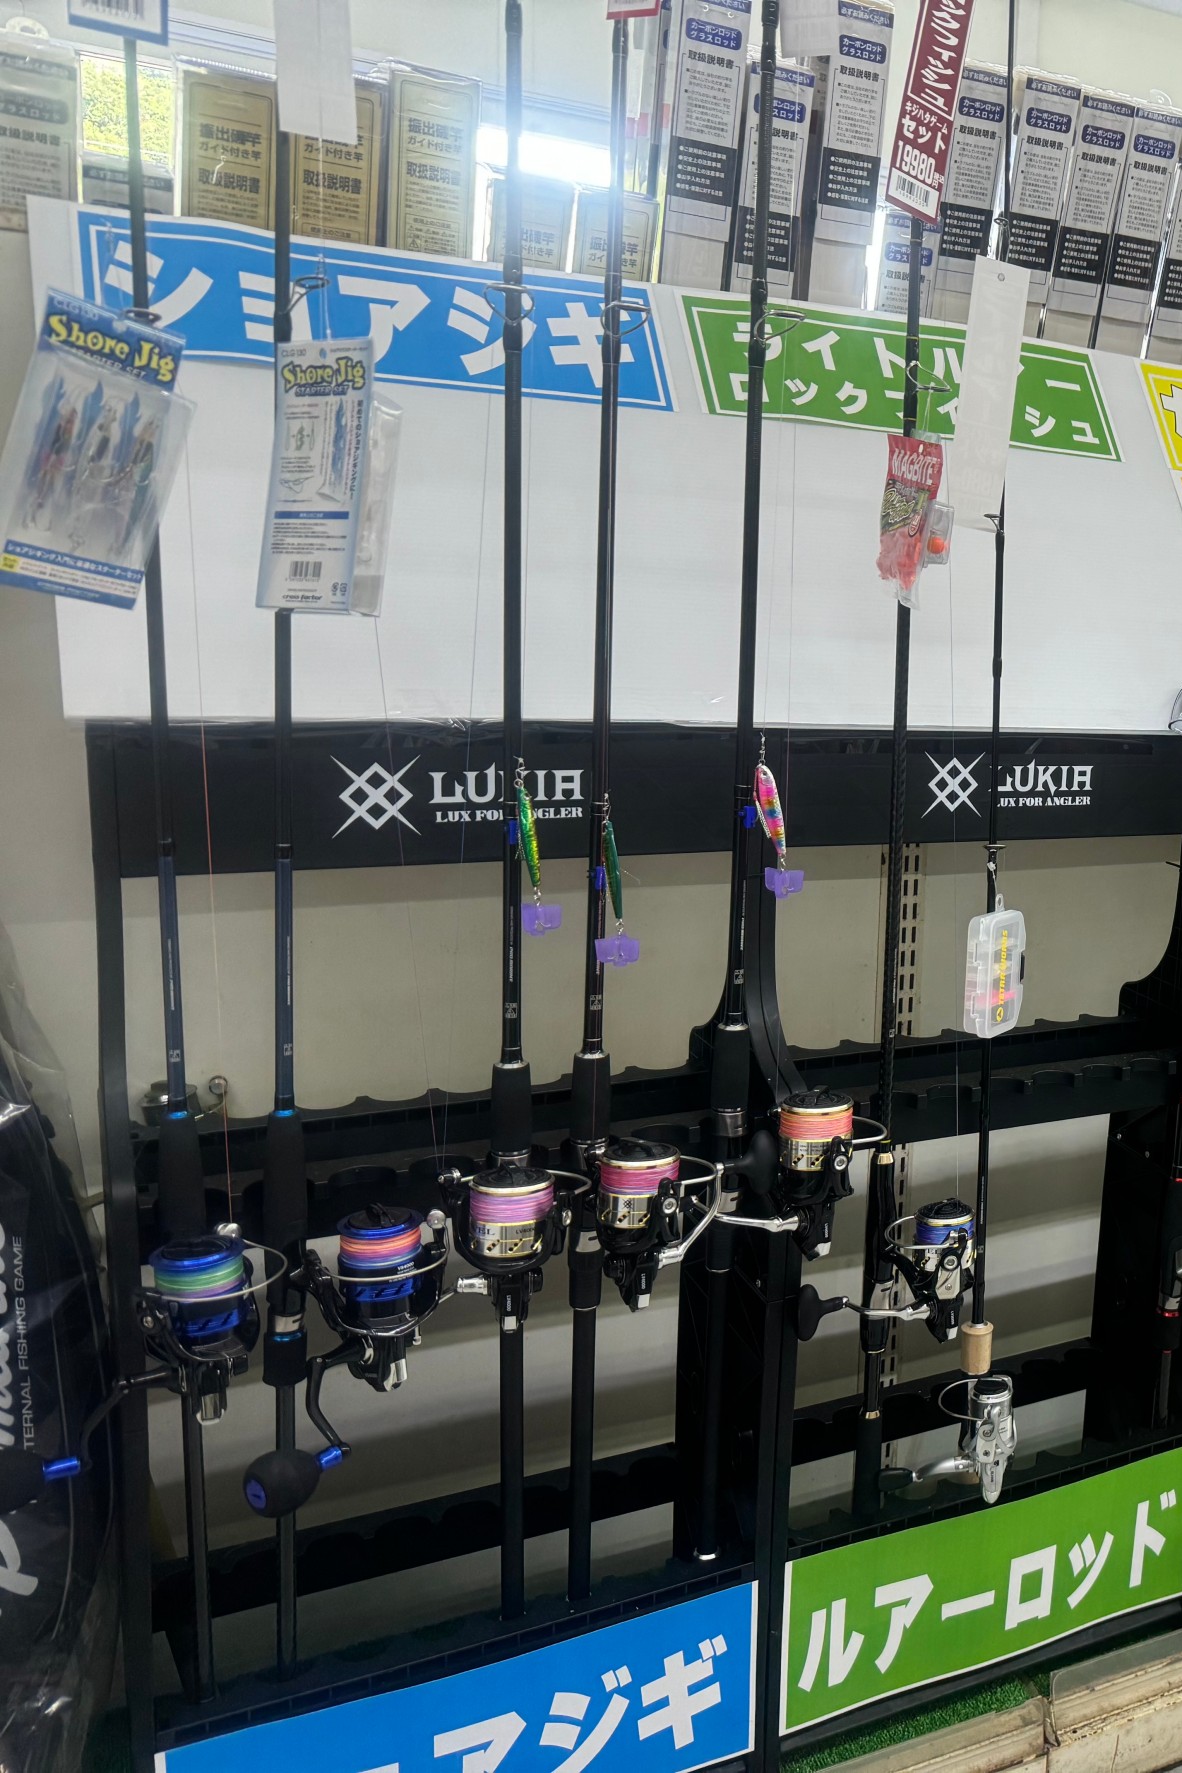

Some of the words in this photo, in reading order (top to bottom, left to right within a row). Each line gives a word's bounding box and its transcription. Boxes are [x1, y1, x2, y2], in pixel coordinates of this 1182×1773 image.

[691, 22, 737, 39] カーボンロッド
[691, 32, 736, 47] グラスロッド
[842, 37, 883, 52] カーボンロッド
[688, 50, 735, 69] 取扱説明書
[842, 46, 882, 61] グラスロッド
[840, 65, 879, 82] 取扱説明書
[1031, 80, 1077, 97] 必ずお読みください
[963, 100, 1000, 113] カーボンロッド
[1087, 99, 1131, 114] 必ずお読みください
[904, 101, 949, 134] キジハタゲーム
[962, 108, 1000, 121] グラスロッド
[1031, 110, 1068, 123] カーボンロッド
[959, 125, 997, 139] 取扱説明書
[1029, 118, 1067, 131] グラスロッド
[901, 114, 946, 154] セット
[1086, 127, 1122, 140] カーボンロッド
[1027, 135, 1063, 150] 取扱説明書
[1085, 135, 1120, 148] グラスロッド
[1139, 137, 1172, 149] カーボンロッド
[1137, 144, 1172, 157] グラスロッド
[896, 141, 935, 184] 19980
[1081, 152, 1116, 167] 取扱説明書
[406, 161, 461, 186] 取扱説明書
[1134, 161, 1168, 175] 取扱説明書
[199, 169, 260, 194] 取扱説明書
[303, 169, 362, 194] 取扱説明書
[49, 315, 130, 359] Shore
[134, 341, 175, 382] Jig
[126, 366, 147, 379] SET
[282, 361, 333, 393] Shore
[335, 356, 365, 390] Jig
[295, 385, 331, 397] STARTER
[332, 385, 350, 395] SET
[892, 449, 937, 486] MAGBITE
[1018, 798, 1042, 806] FOR
[1045, 796, 1090, 806] ANGLER
[435, 810, 471, 823] LUX
[475, 809, 503, 821] FO
[11, 1234, 23, 1290] GAME
[18, 1293, 30, 1372] FISHING
[798, 1487, 1178, 1693] ルアーロッド
